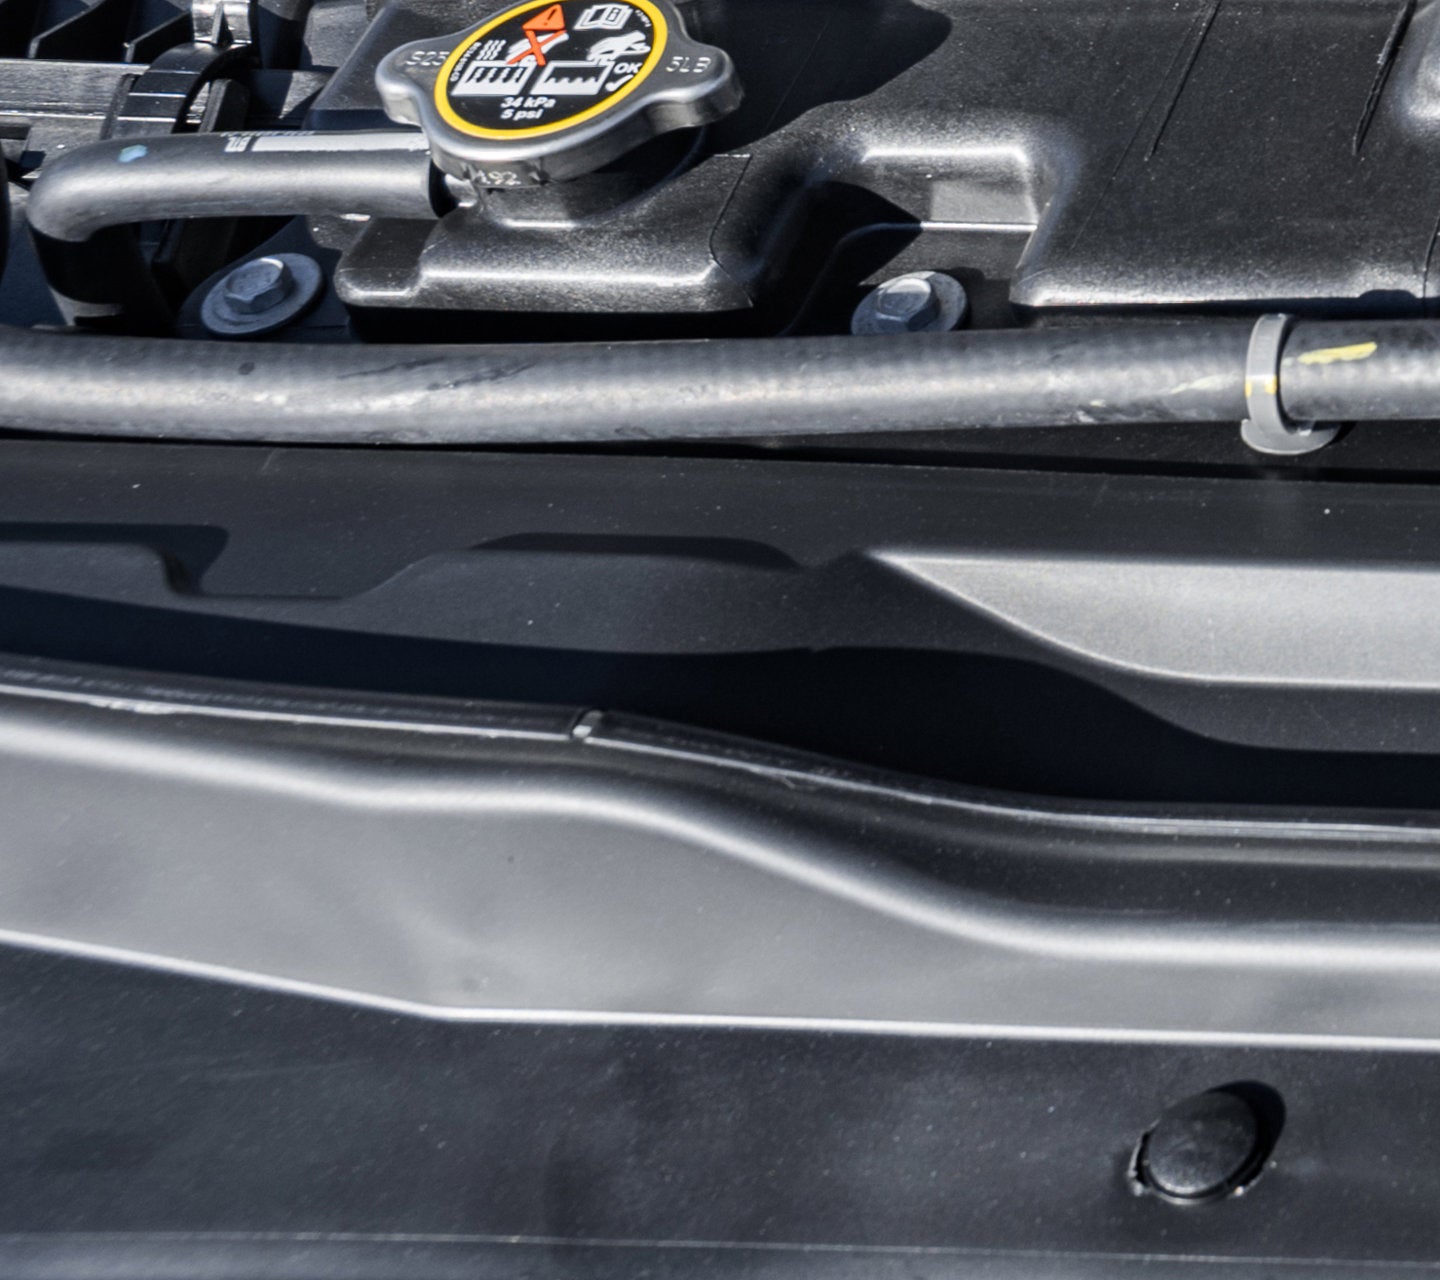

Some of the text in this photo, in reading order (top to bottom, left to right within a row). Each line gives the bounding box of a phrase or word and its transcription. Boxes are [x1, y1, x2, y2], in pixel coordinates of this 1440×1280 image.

[614, 61, 643, 74] OK
[501, 97, 557, 110] 34 kPa
[501, 109, 543, 122] 5 psi
